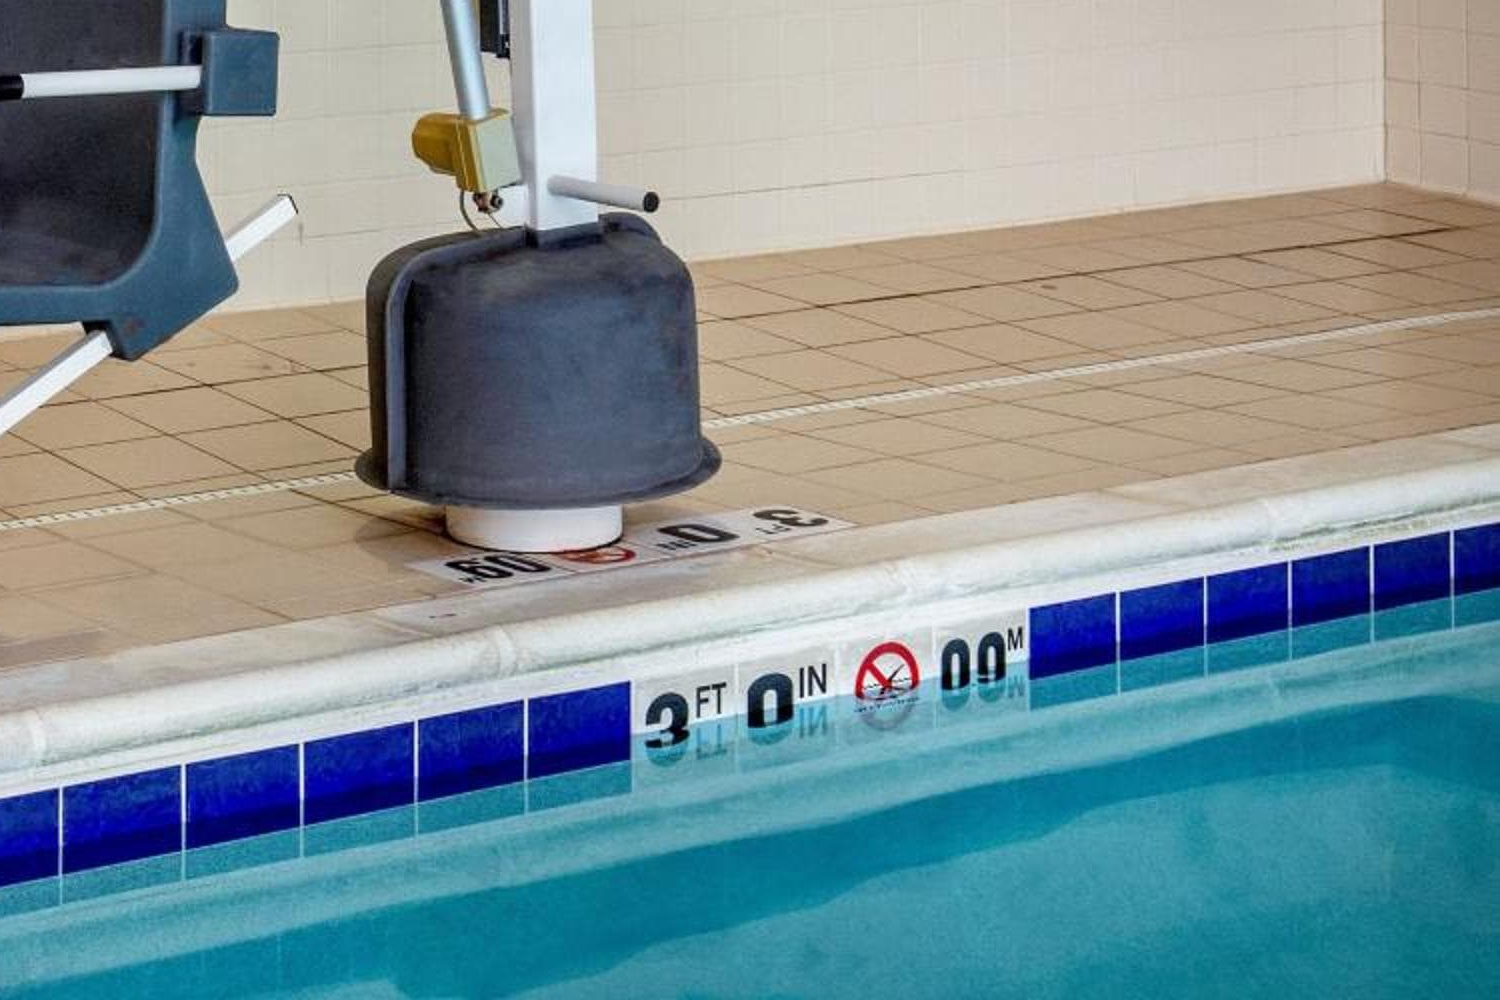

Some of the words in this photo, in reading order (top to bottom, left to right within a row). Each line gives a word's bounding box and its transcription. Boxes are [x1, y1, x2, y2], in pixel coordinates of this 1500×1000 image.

[753, 508, 829, 527] 3
[657, 523, 740, 543] 0
[445, 552, 552, 579] 09
[645, 692, 690, 748] 3
[695, 682, 728, 719] FT
[747, 673, 794, 729] 0
[798, 663, 828, 698] IN
[1008, 627, 1024, 651] M
